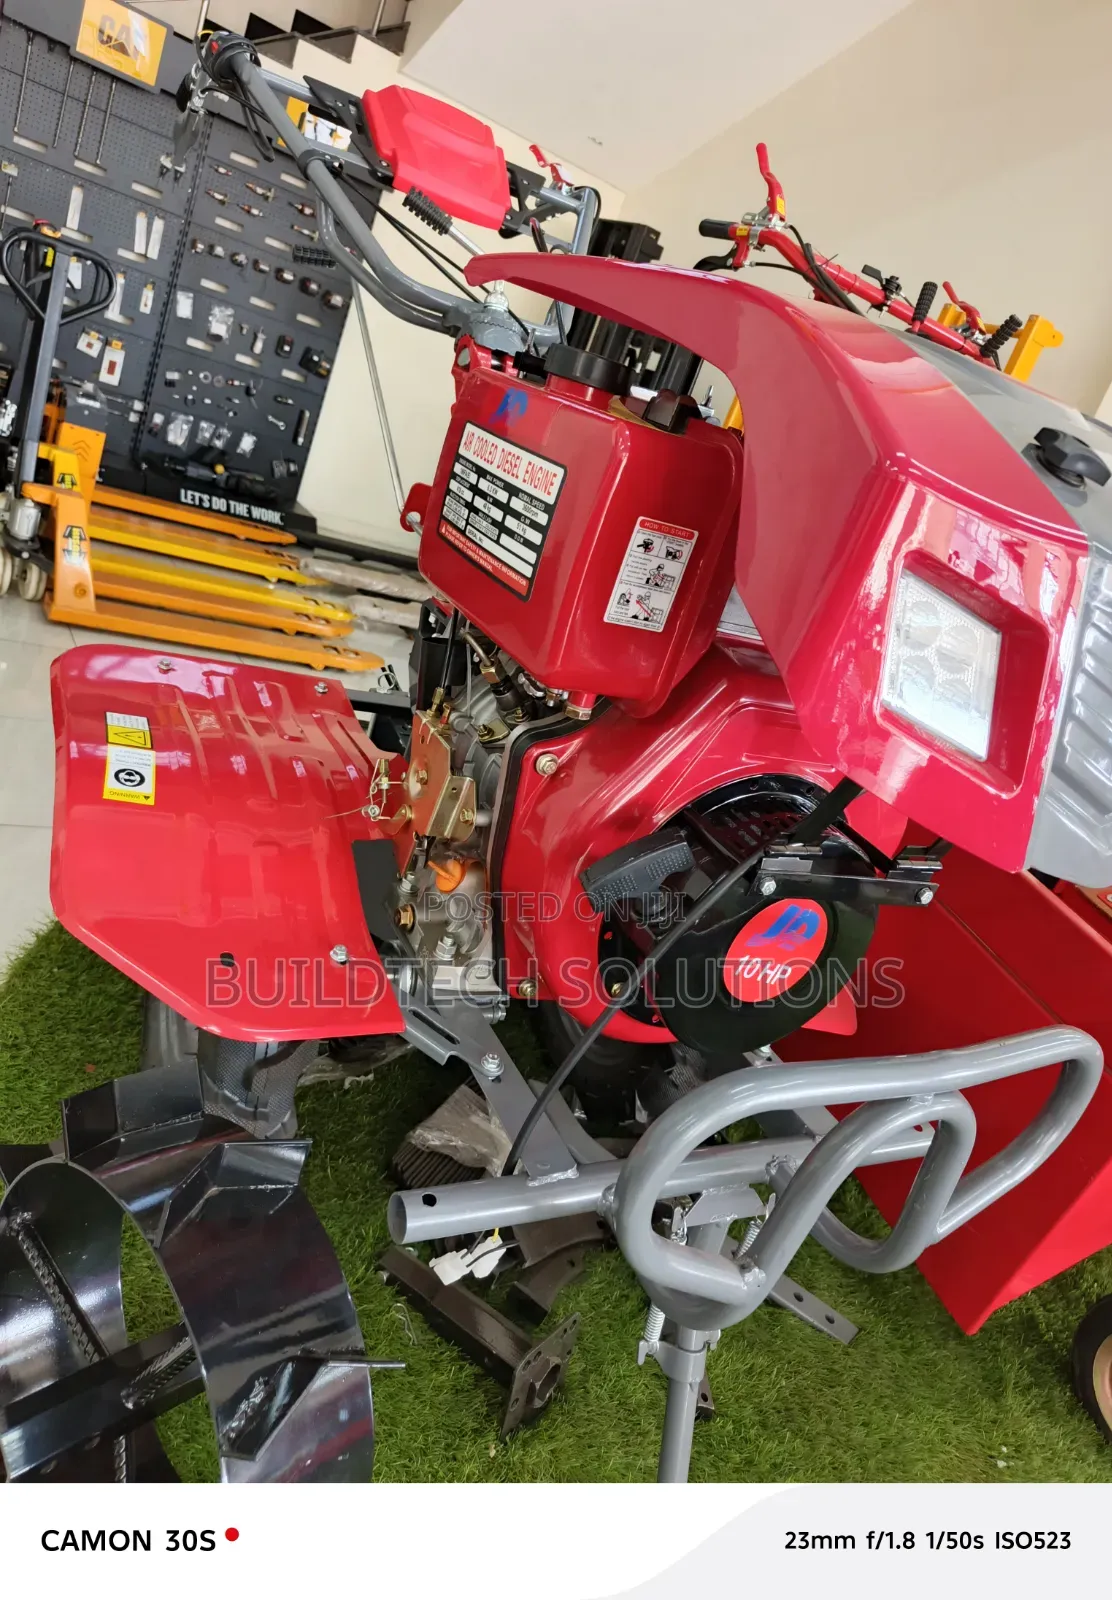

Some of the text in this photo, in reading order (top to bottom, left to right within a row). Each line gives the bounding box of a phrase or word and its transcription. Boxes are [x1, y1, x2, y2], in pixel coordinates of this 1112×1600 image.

[463, 431, 474, 452] AIR
[473, 436, 498, 465] COOLED
[497, 448, 523, 480] DIESEL
[522, 461, 557, 496] ENGINE
[181, 488, 210, 508] LET'S
[212, 496, 227, 512] DO
[229, 500, 249, 517] THE
[532, 499, 545, 511] SPEED
[645, 521, 659, 530] HOW
[671, 528, 690, 537] START
[501, 564, 527, 587] INFORMATION
[109, 790, 141, 799] WARNING
